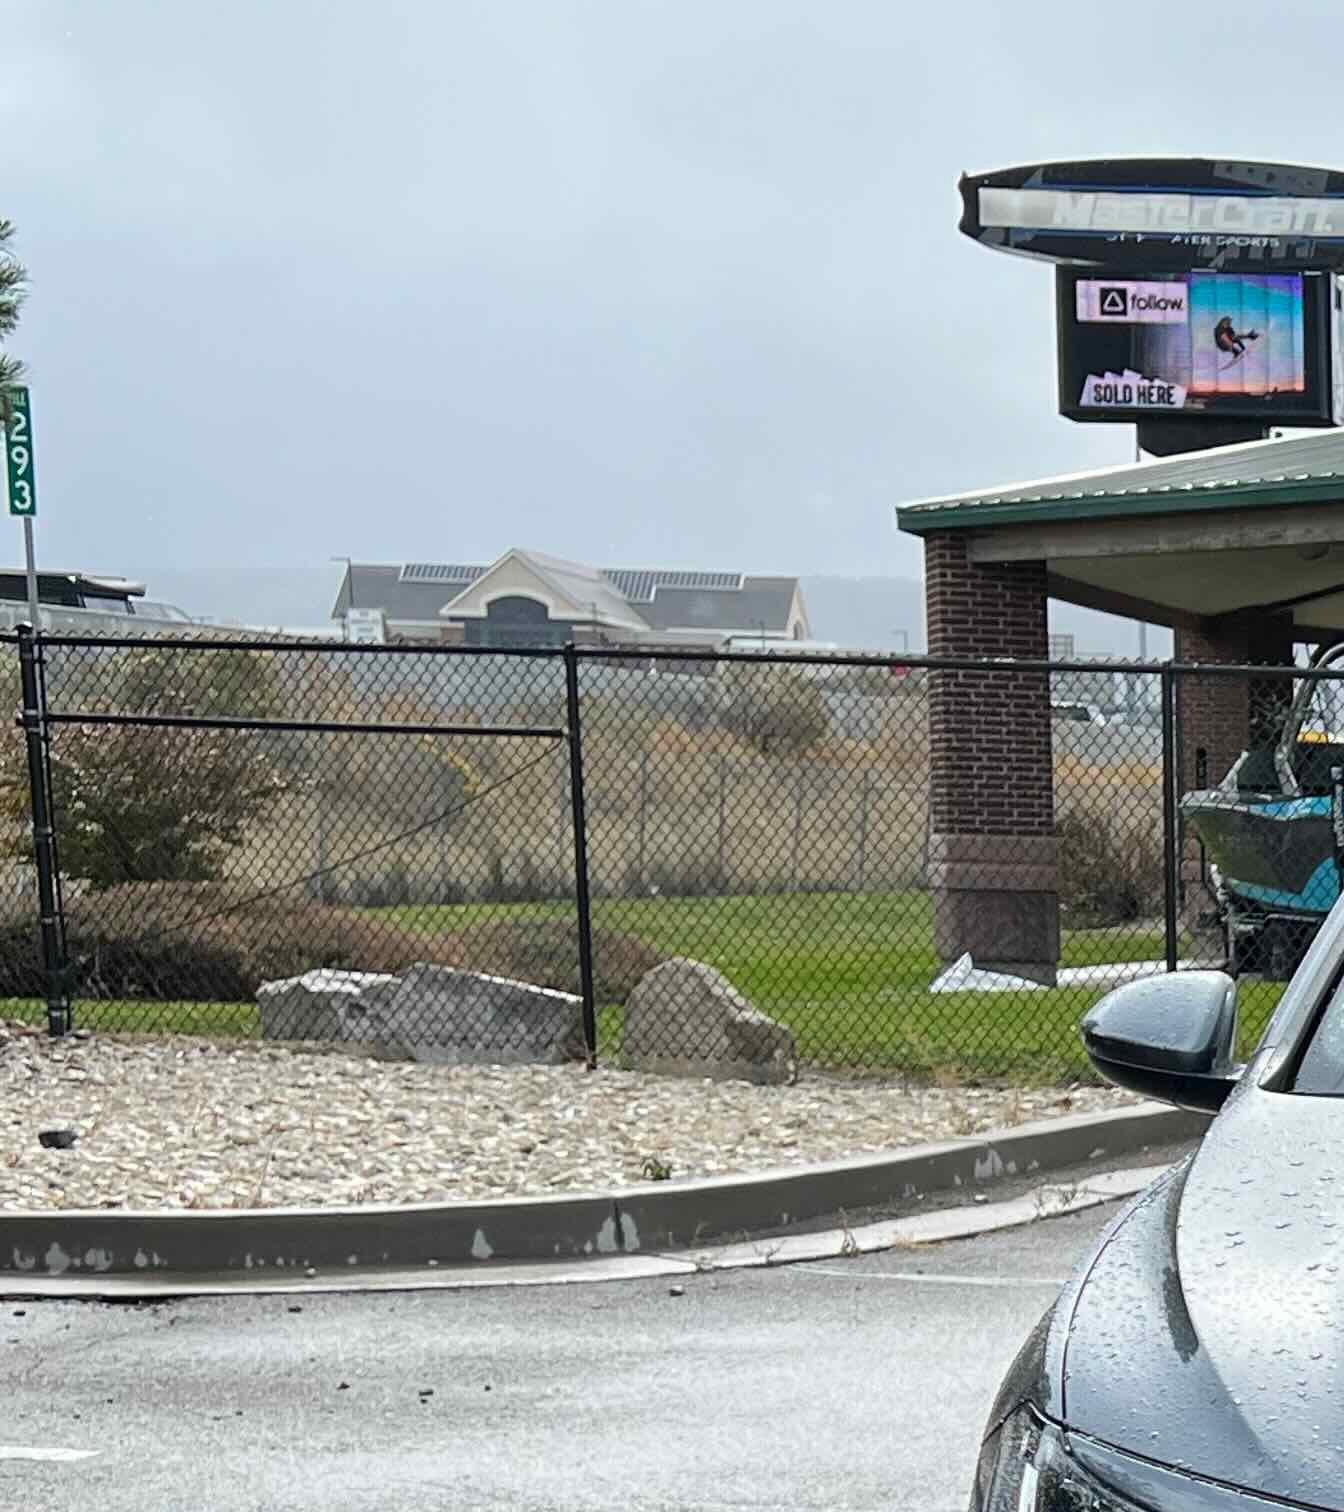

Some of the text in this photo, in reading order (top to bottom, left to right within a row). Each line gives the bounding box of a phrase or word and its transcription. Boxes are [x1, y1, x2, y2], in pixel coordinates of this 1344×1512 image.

[1215, 235, 1281, 248] SPORTS
[1093, 384, 1176, 405] SOLD HERE
[10, 411, 32, 510] 293
